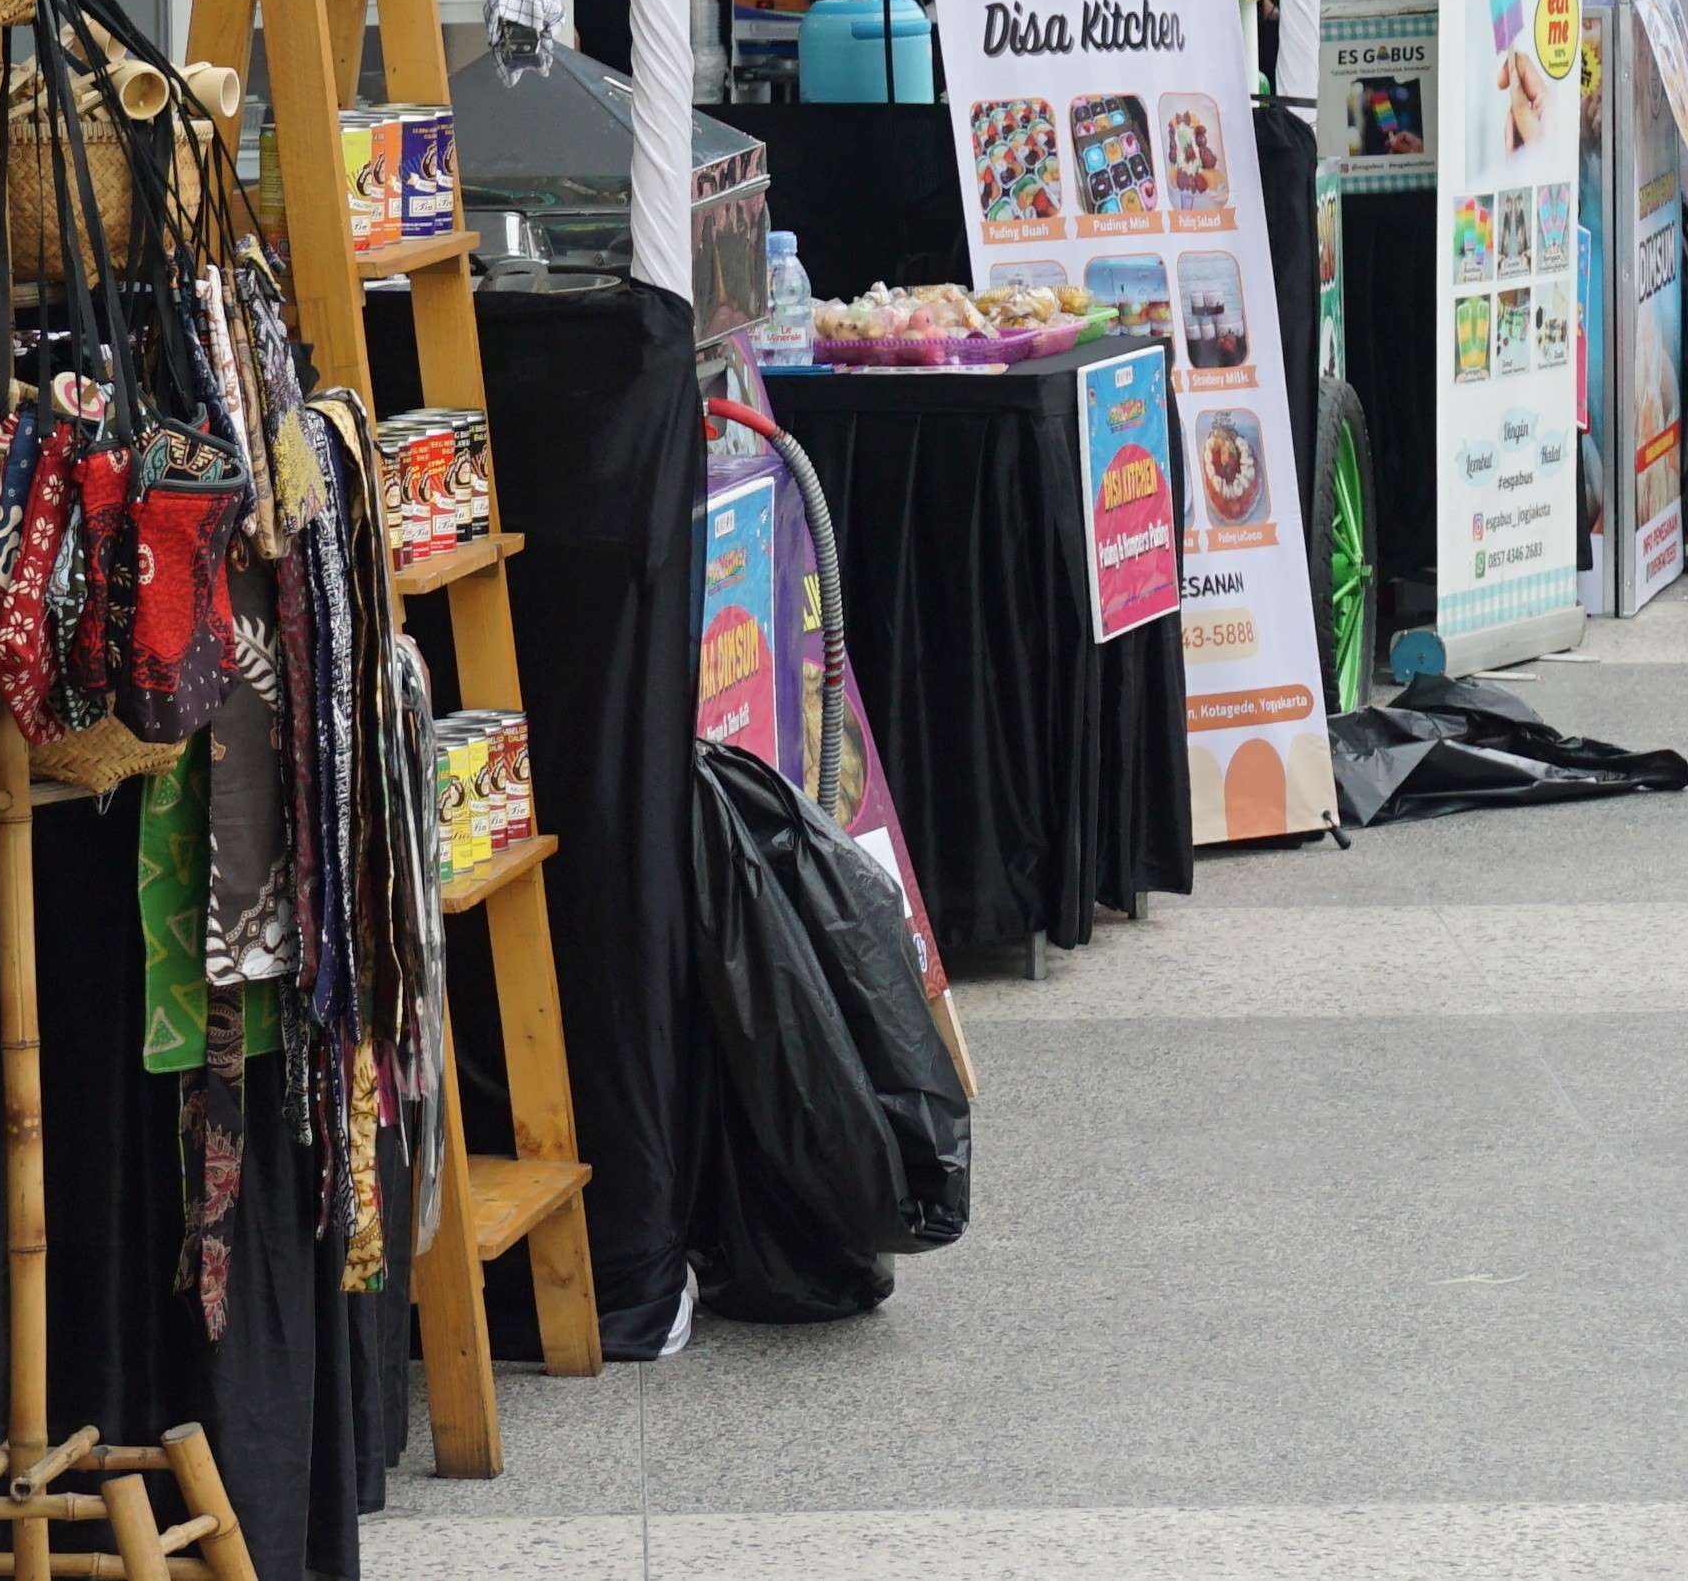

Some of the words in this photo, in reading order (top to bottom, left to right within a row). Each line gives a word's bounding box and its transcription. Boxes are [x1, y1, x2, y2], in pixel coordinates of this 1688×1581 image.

[983, 0, 1075, 57] Disa
[1548, 19, 1569, 46] me
[1338, 49, 1359, 66] ES
[989, 226, 1019, 241] Puding
[1021, 224, 1050, 237] Buah
[1093, 219, 1128, 234] Puding
[1129, 218, 1151, 230] Mini
[1639, 221, 1676, 304] DIMSUM
[1225, 371, 1249, 384] Milk
[1122, 456, 1158, 505] KITCHEN
[1182, 621, 1255, 650] 43-5888
[717, 615, 760, 693] DIMSUM
[1200, 701, 1258, 721] Kotagede,
[1260, 695, 1308, 714] Yogyakarta
